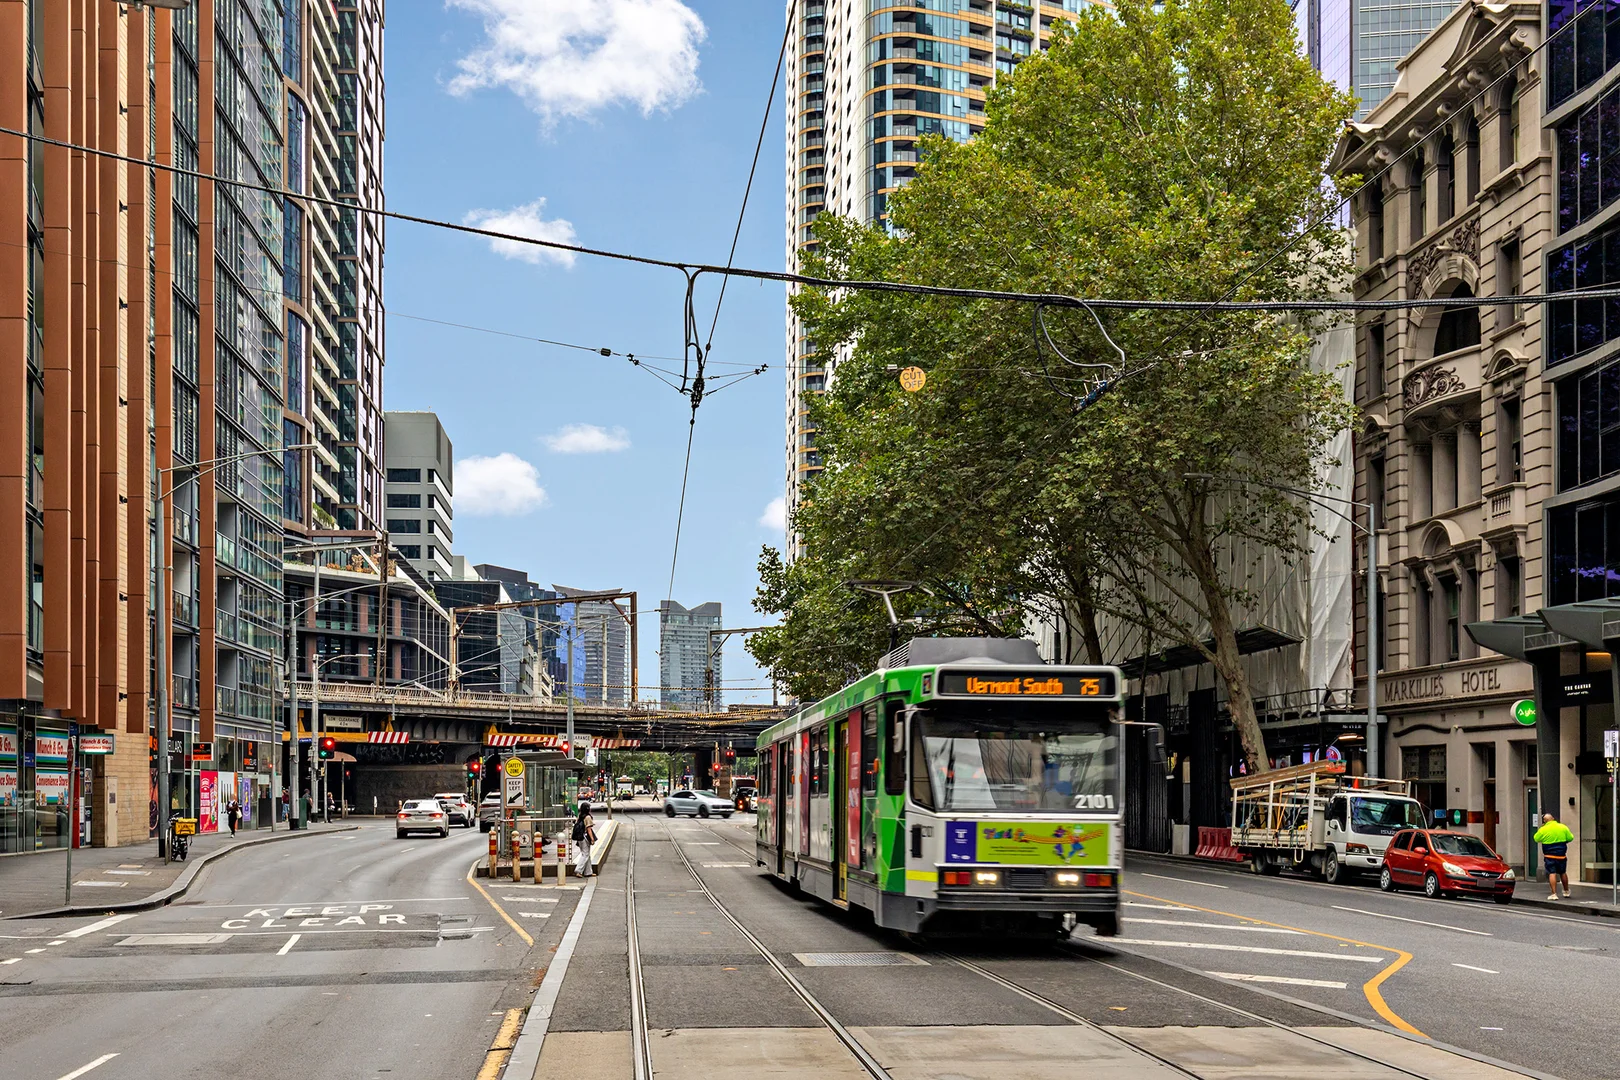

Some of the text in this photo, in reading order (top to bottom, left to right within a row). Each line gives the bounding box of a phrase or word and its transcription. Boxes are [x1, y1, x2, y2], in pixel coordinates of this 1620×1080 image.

[902, 371, 922, 381] CUT
[903, 379, 923, 389] OFF
[966, 677, 1100, 695] Vermont South 75
[1384, 668, 1501, 702] MARKILLIE'S HOTEL
[37, 739, 52, 754] Munch
[36, 775, 69, 786] Convenience Store
[1074, 794, 1115, 809] 2101
[243, 904, 394, 918] KEEP
[221, 914, 408, 929] CLEAR
